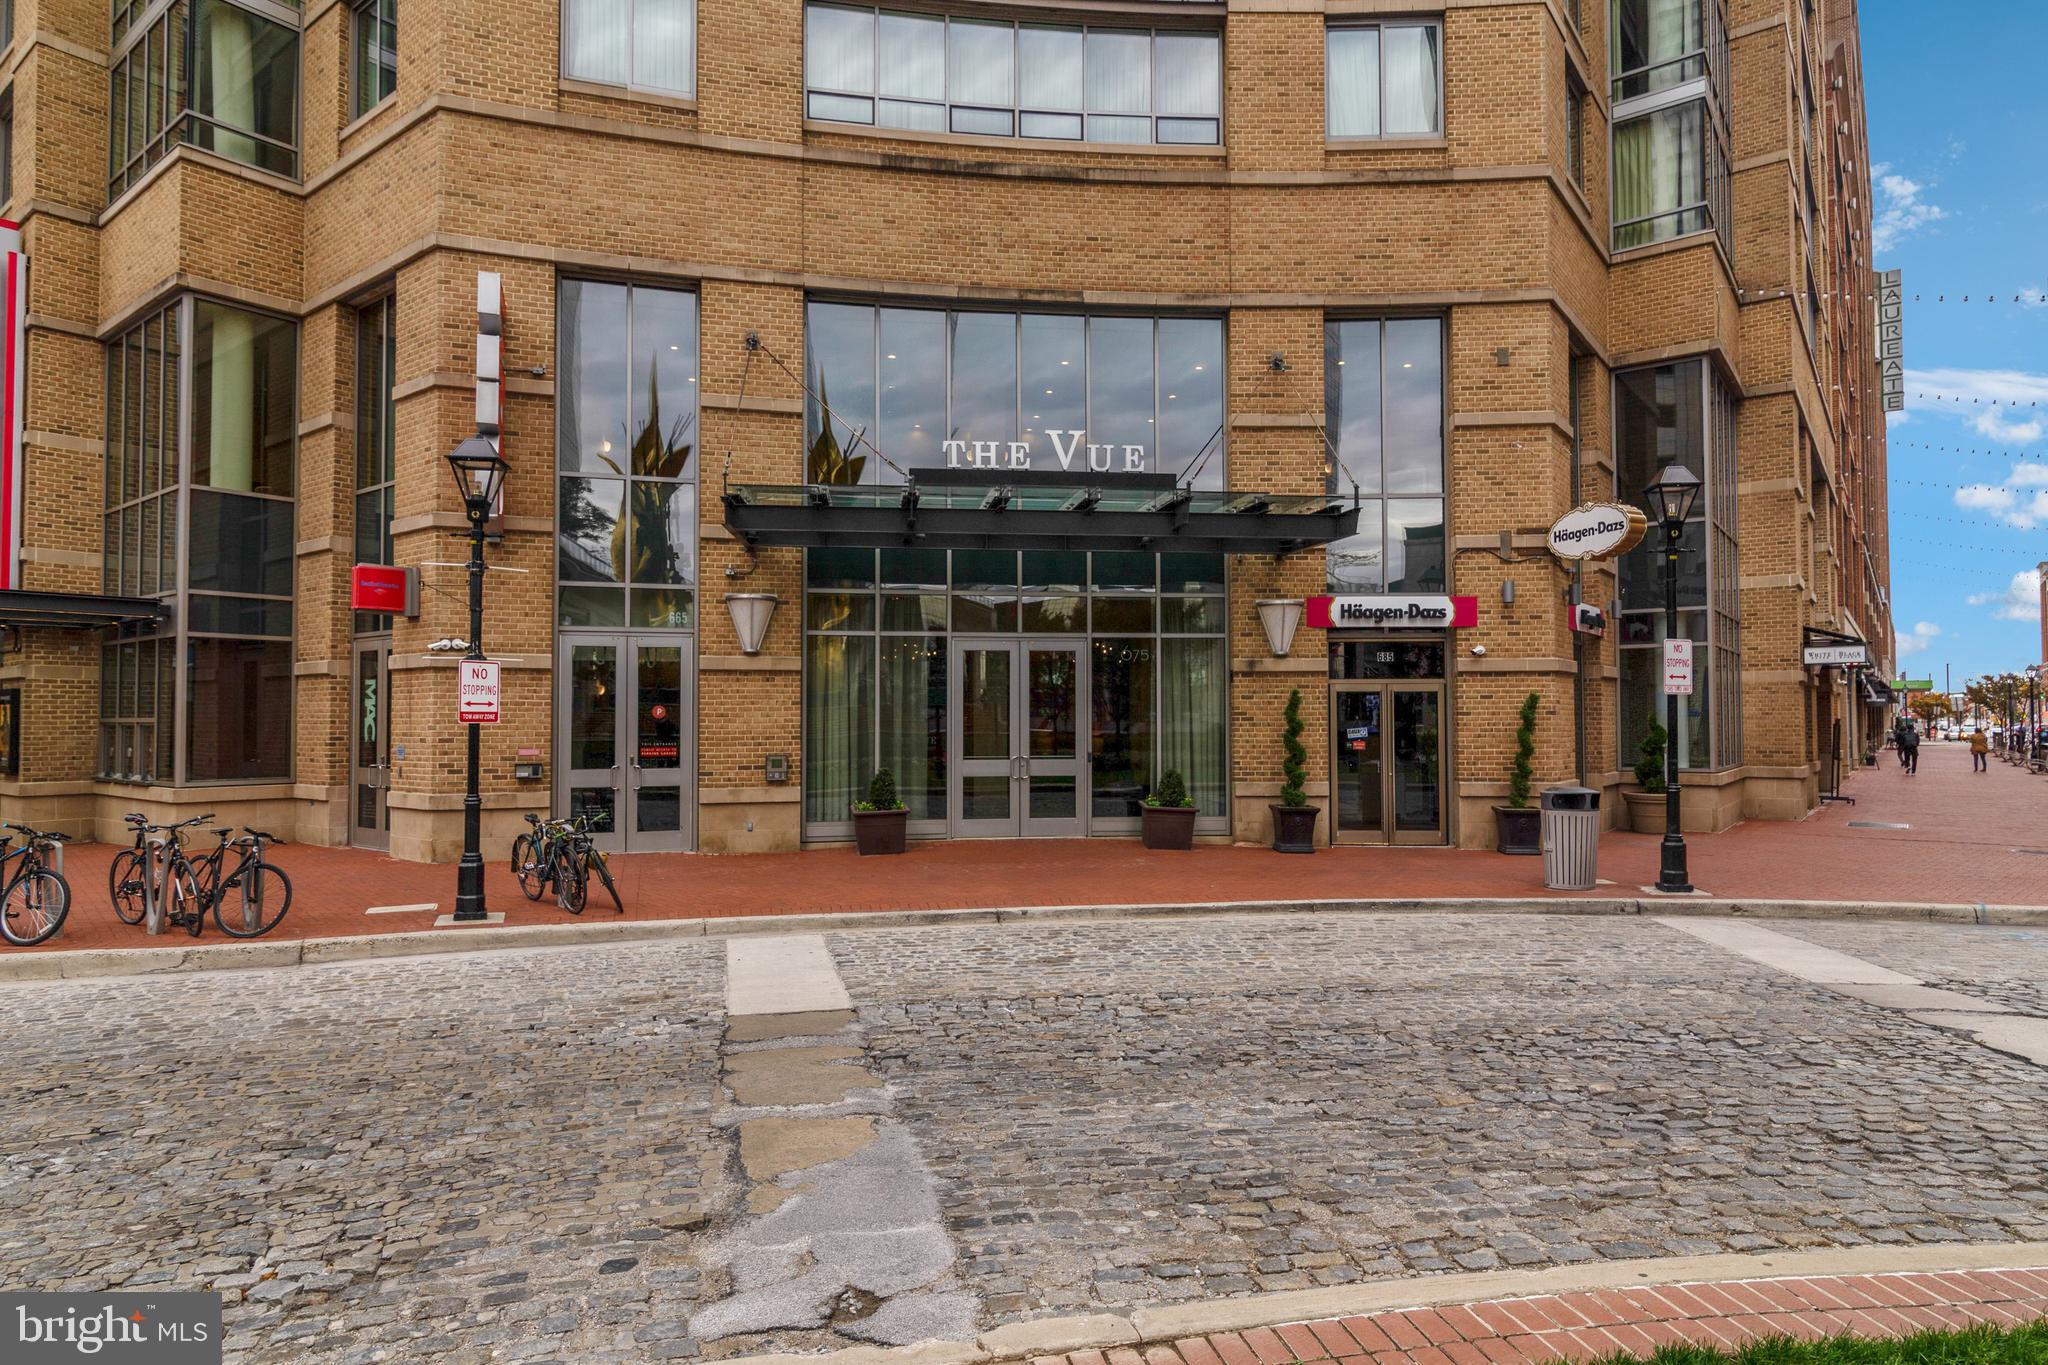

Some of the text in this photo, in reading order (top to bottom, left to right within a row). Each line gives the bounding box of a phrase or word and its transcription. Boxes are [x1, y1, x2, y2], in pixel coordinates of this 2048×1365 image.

[1884, 273, 1902, 409] LAUREATE
[942, 430, 1145, 472] THE VUE
[1553, 520, 1625, 543] Häagen-Dazs
[669, 611, 688, 624] 665
[1340, 603, 1447, 624] Häagen-Dazs
[1120, 645, 1149, 662] 675
[1673, 644, 1683, 653] NO
[1376, 651, 1395, 662] 685
[1666, 658, 1690, 668] STOPPING
[472, 668, 488, 680] NO
[462, 684, 497, 696] STOPPING
